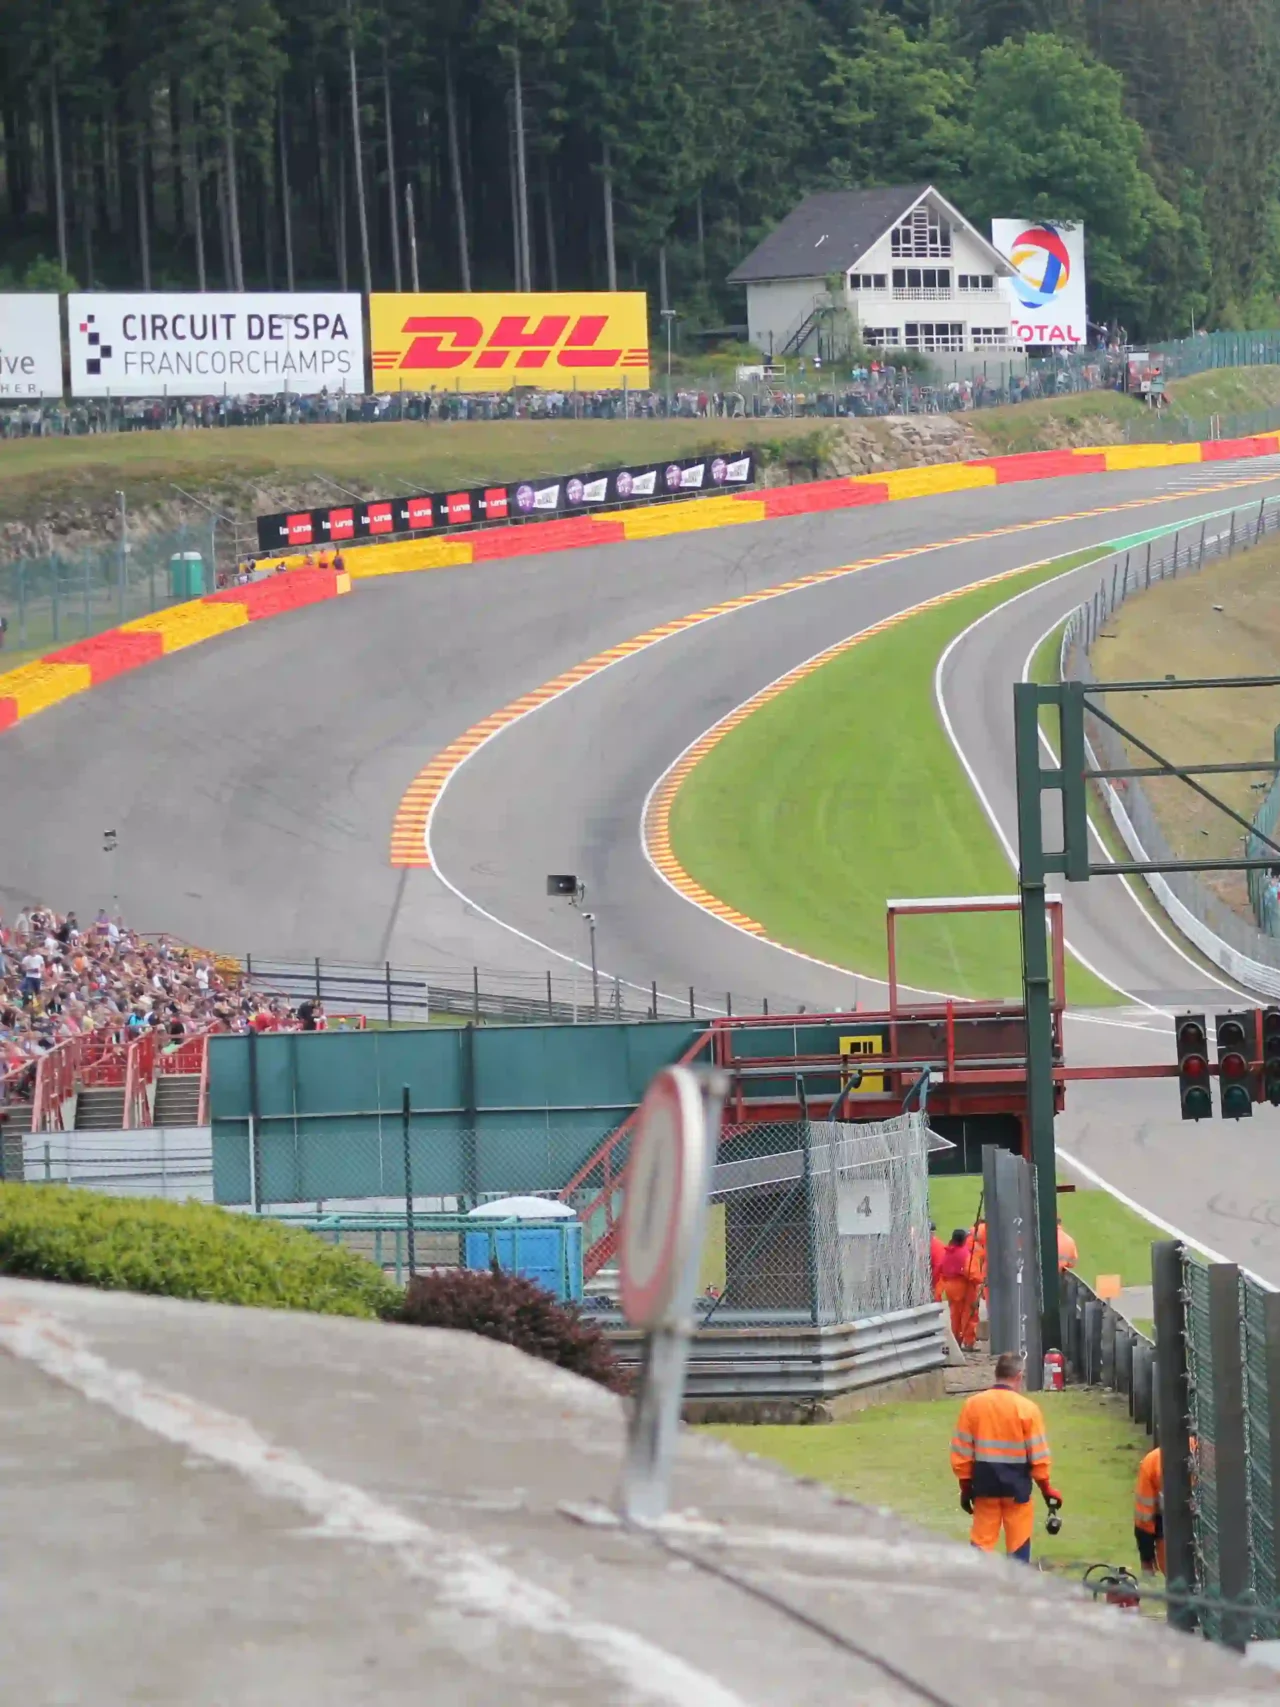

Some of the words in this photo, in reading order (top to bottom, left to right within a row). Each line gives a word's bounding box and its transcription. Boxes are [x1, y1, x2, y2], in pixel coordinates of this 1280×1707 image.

[122, 313, 236, 341] CIRCUIT
[247, 313, 284, 341] DE
[294, 313, 349, 340] SPA
[1011, 320, 1081, 342] OTAL
[398, 315, 622, 369] DHL
[124, 349, 351, 375] FRANCORCHAMPS
[857, 1195, 872, 1217] 4
